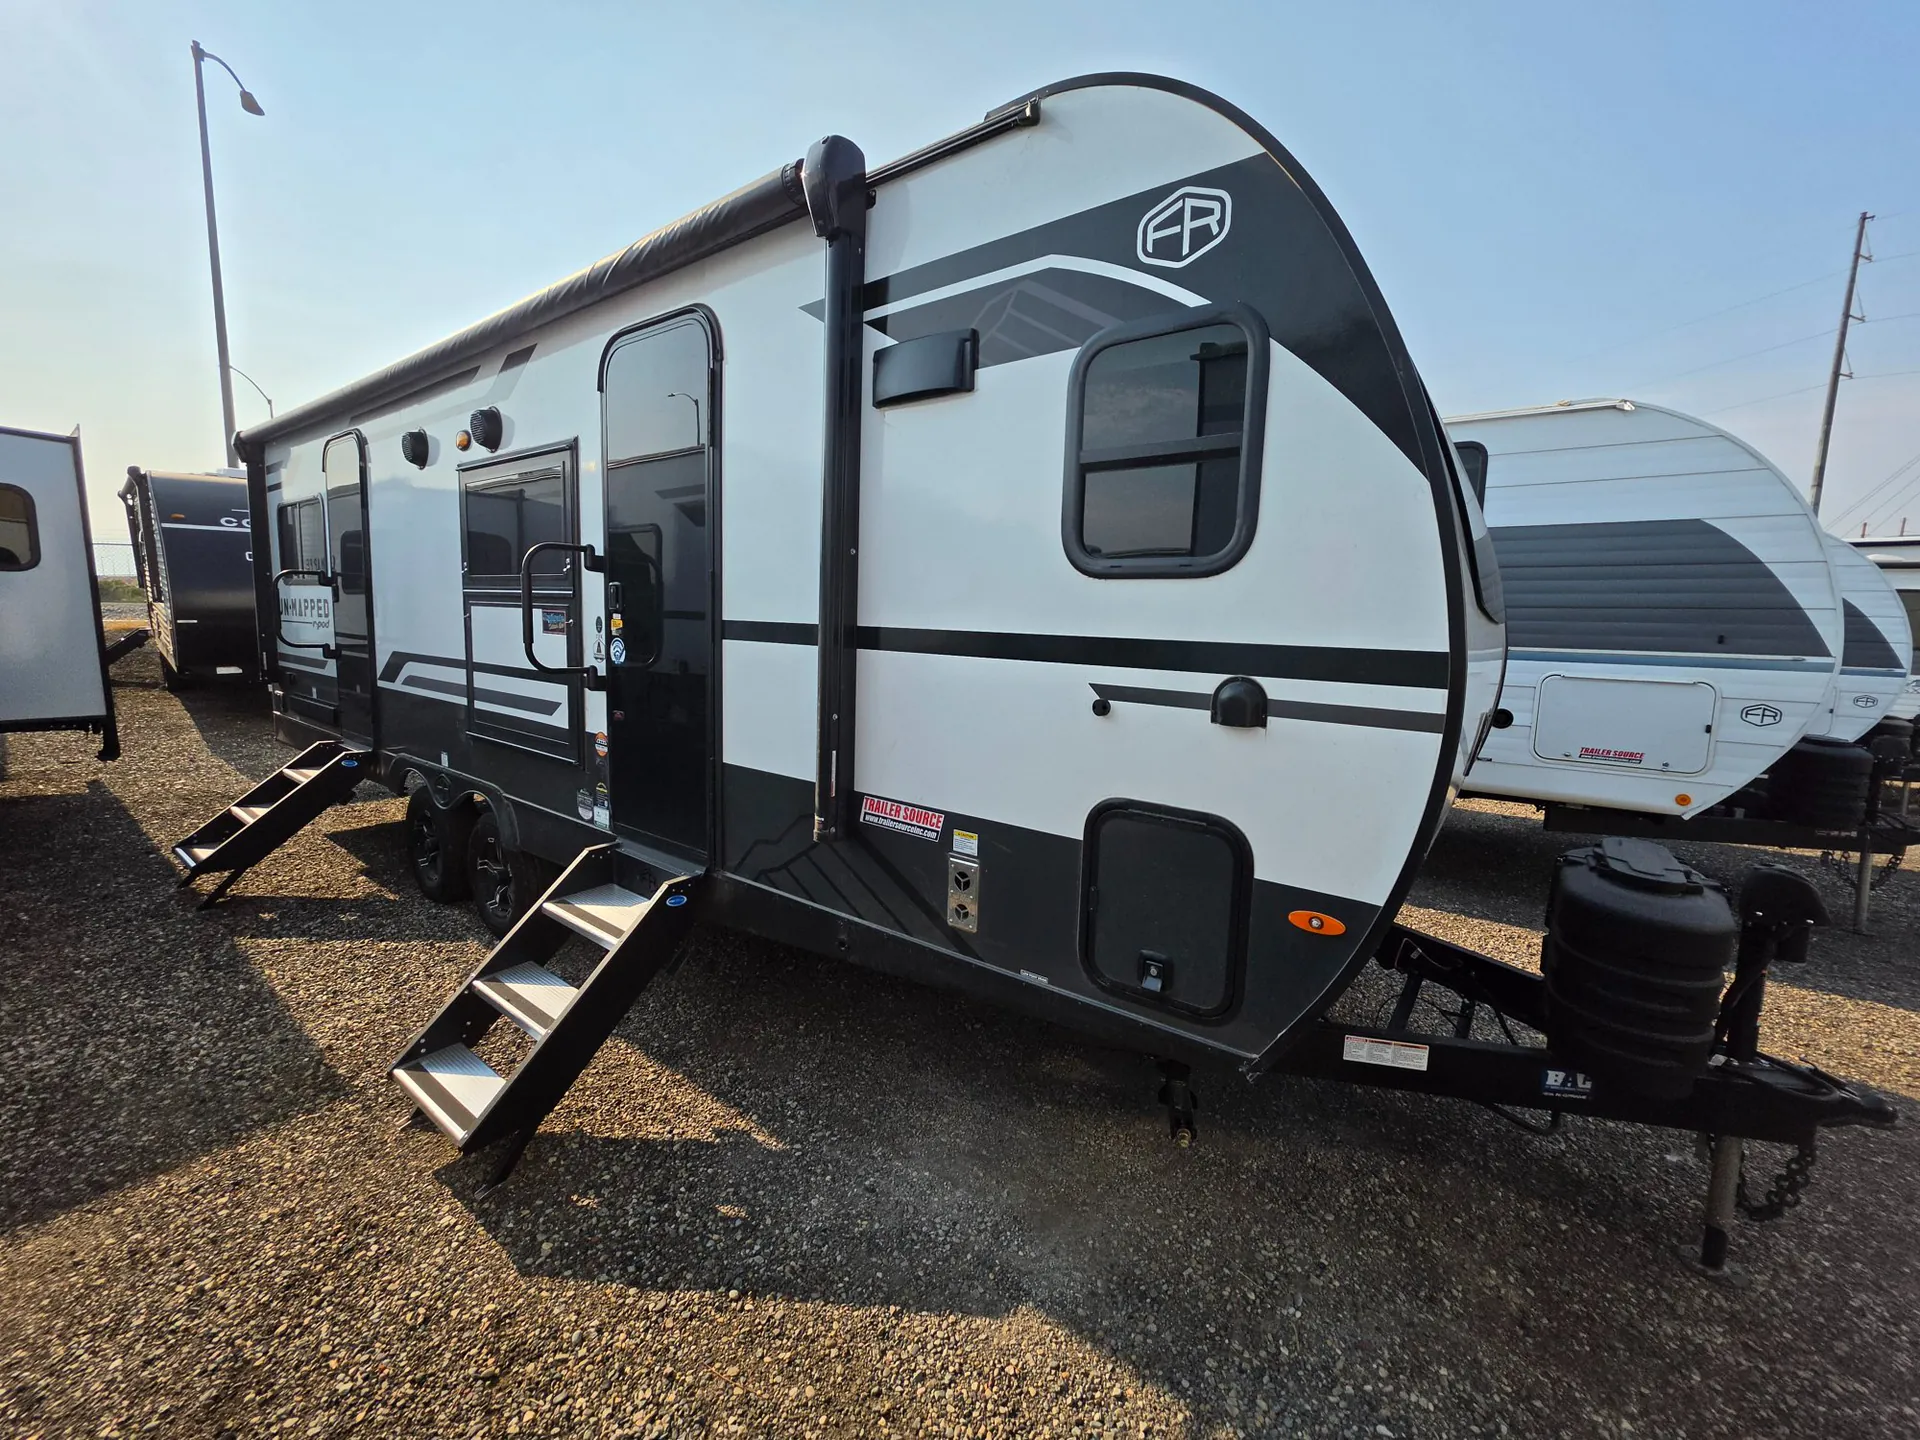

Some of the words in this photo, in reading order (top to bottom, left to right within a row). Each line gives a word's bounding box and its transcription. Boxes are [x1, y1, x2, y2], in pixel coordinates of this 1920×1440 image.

[1146, 197, 1222, 257] FR
[1745, 707, 1779, 724] FR
[1580, 746, 1612, 756] TRAILER
[1612, 750, 1645, 759] SOURCE
[863, 797, 901, 818] TRAILER
[903, 807, 943, 829] SOURCE
[865, 814, 937, 839] www.trailersourceinc.com
